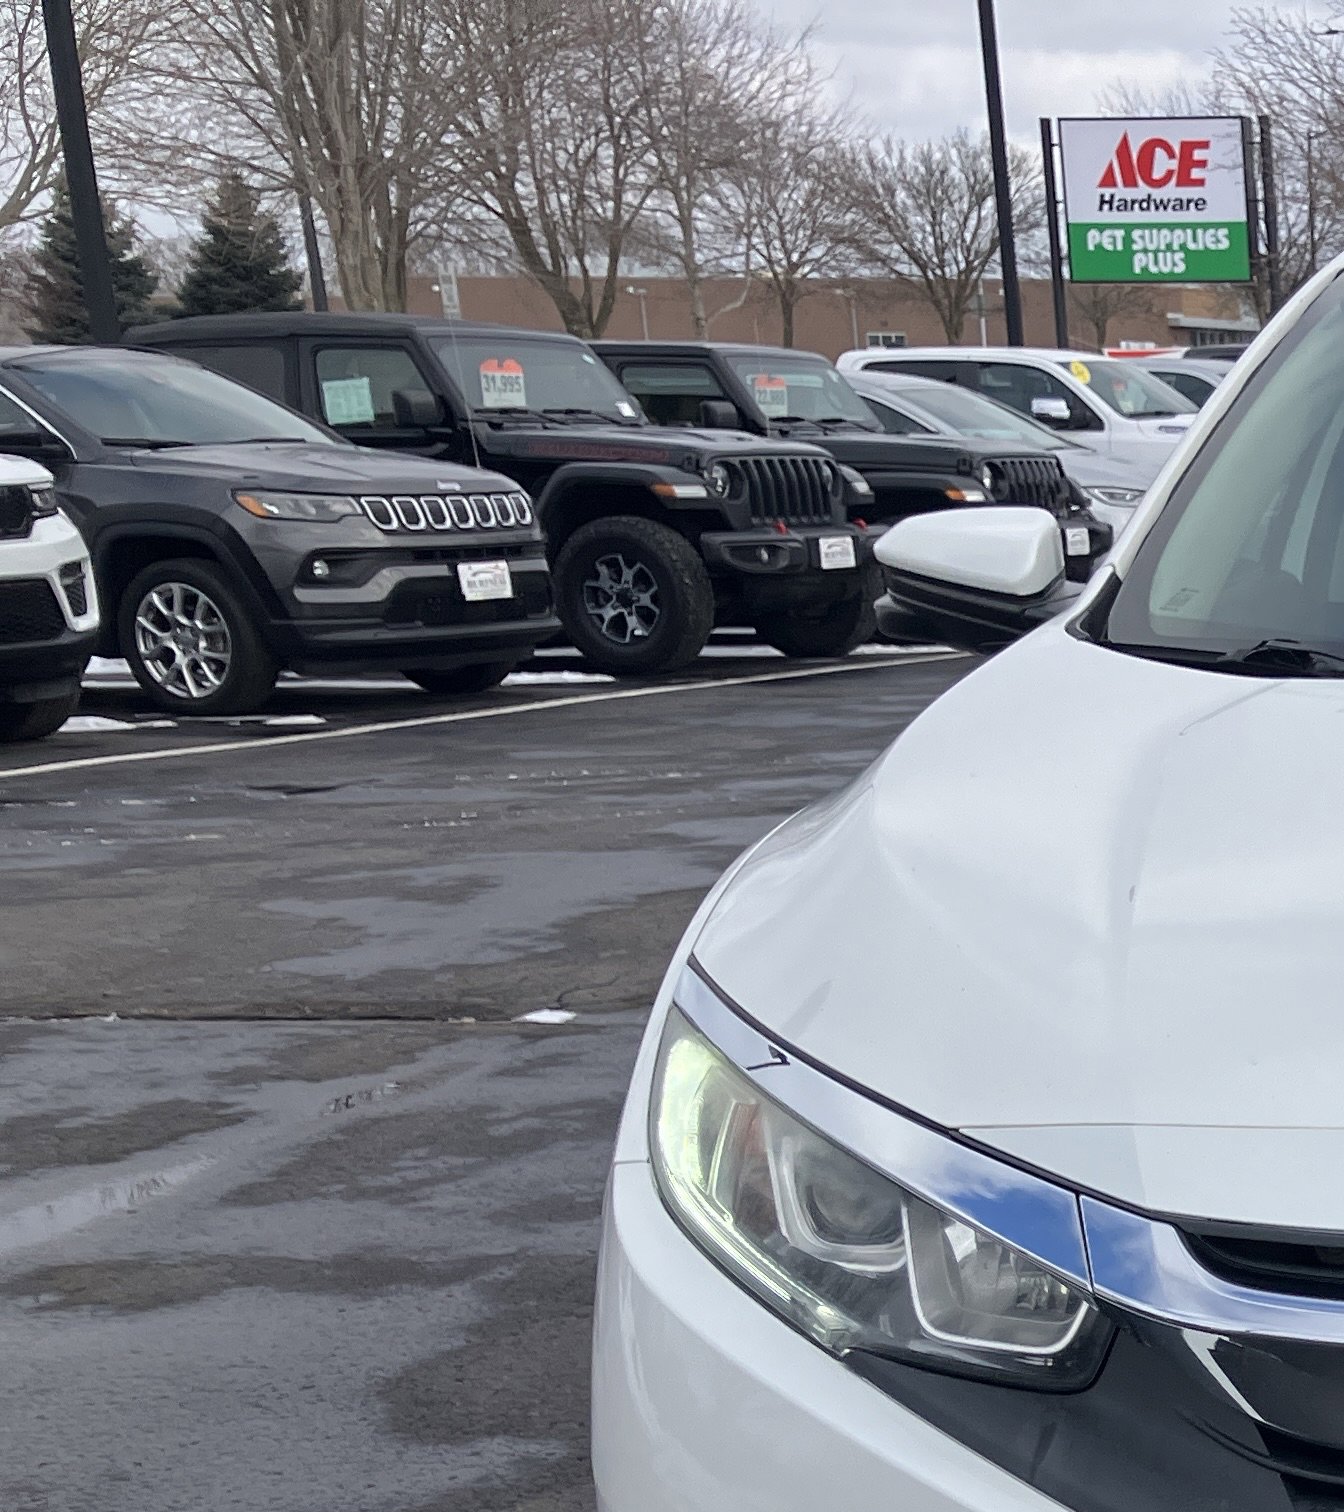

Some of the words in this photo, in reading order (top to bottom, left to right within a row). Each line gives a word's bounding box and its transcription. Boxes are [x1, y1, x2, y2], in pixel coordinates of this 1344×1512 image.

[1098, 130, 1211, 188] ACE
[1098, 193, 1207, 212] Hardware
[1087, 228, 1126, 251] PET
[1131, 228, 1230, 251] SUPPLIES
[1133, 251, 1186, 274] PLUS
